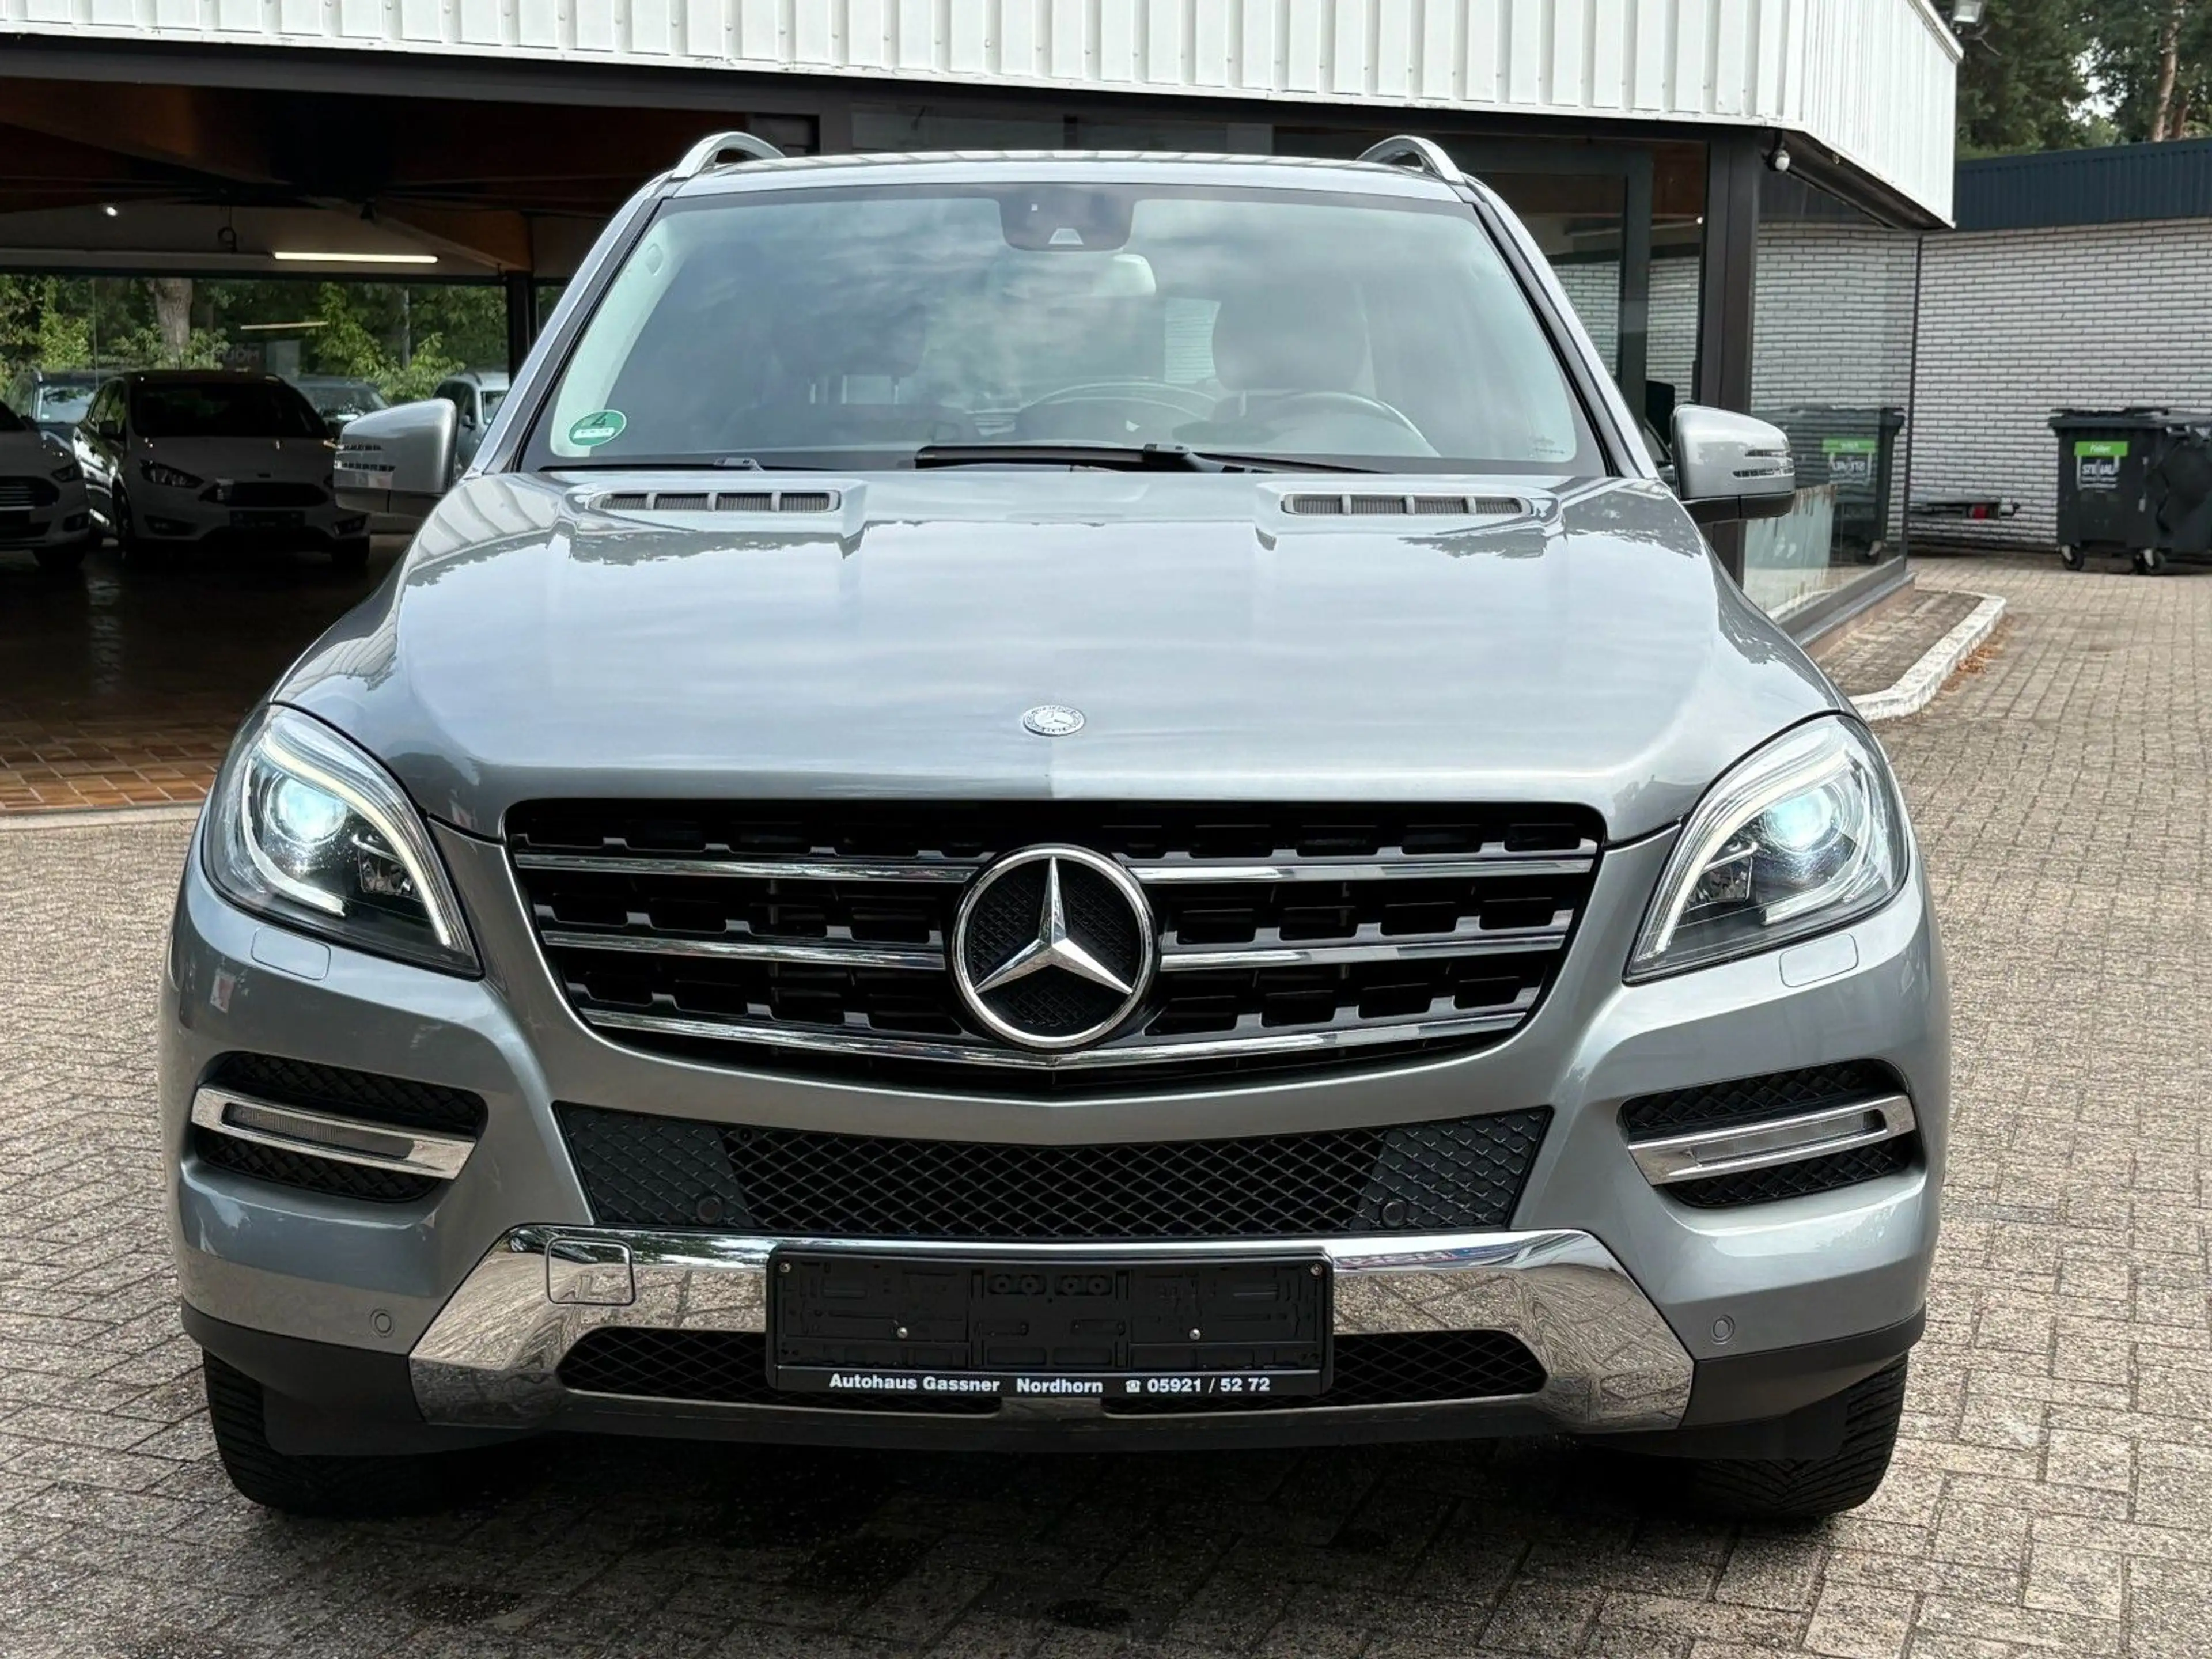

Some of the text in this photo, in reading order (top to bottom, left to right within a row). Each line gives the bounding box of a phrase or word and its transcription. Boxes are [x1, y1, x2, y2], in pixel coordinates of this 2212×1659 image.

[590, 412, 608, 427] 4
[829, 1373, 1270, 1393] Autohaus Gassner Nordhorn 05921 / 52 72
